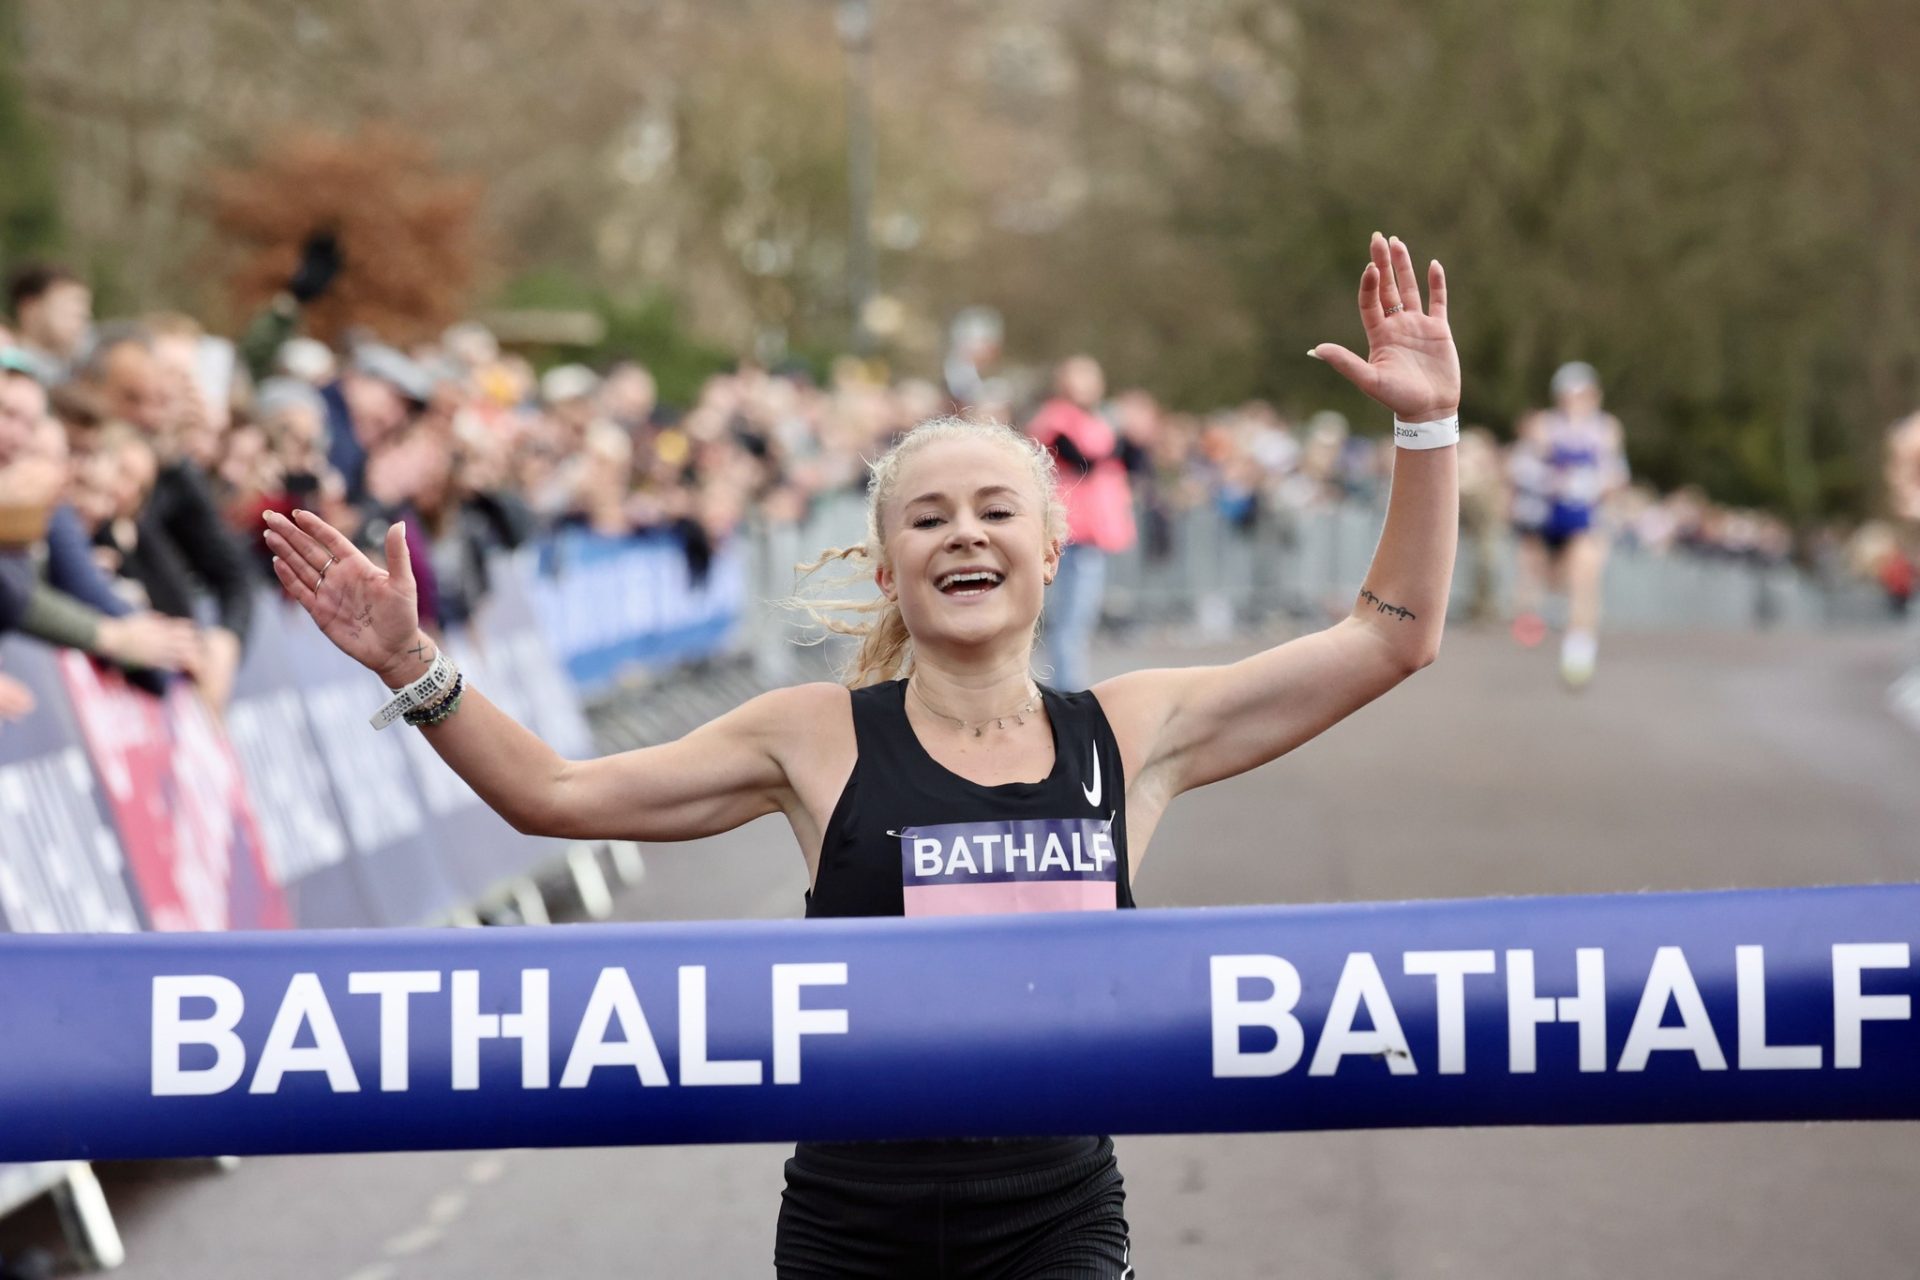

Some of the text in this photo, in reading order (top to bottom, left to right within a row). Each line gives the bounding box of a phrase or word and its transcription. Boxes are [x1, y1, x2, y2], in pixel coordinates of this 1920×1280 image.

[1401, 429, 1418, 438] 2024
[913, 832, 1111, 877] BATHALF
[151, 962, 849, 1097] BATHALF
[1210, 943, 1911, 1078] BATHALF
